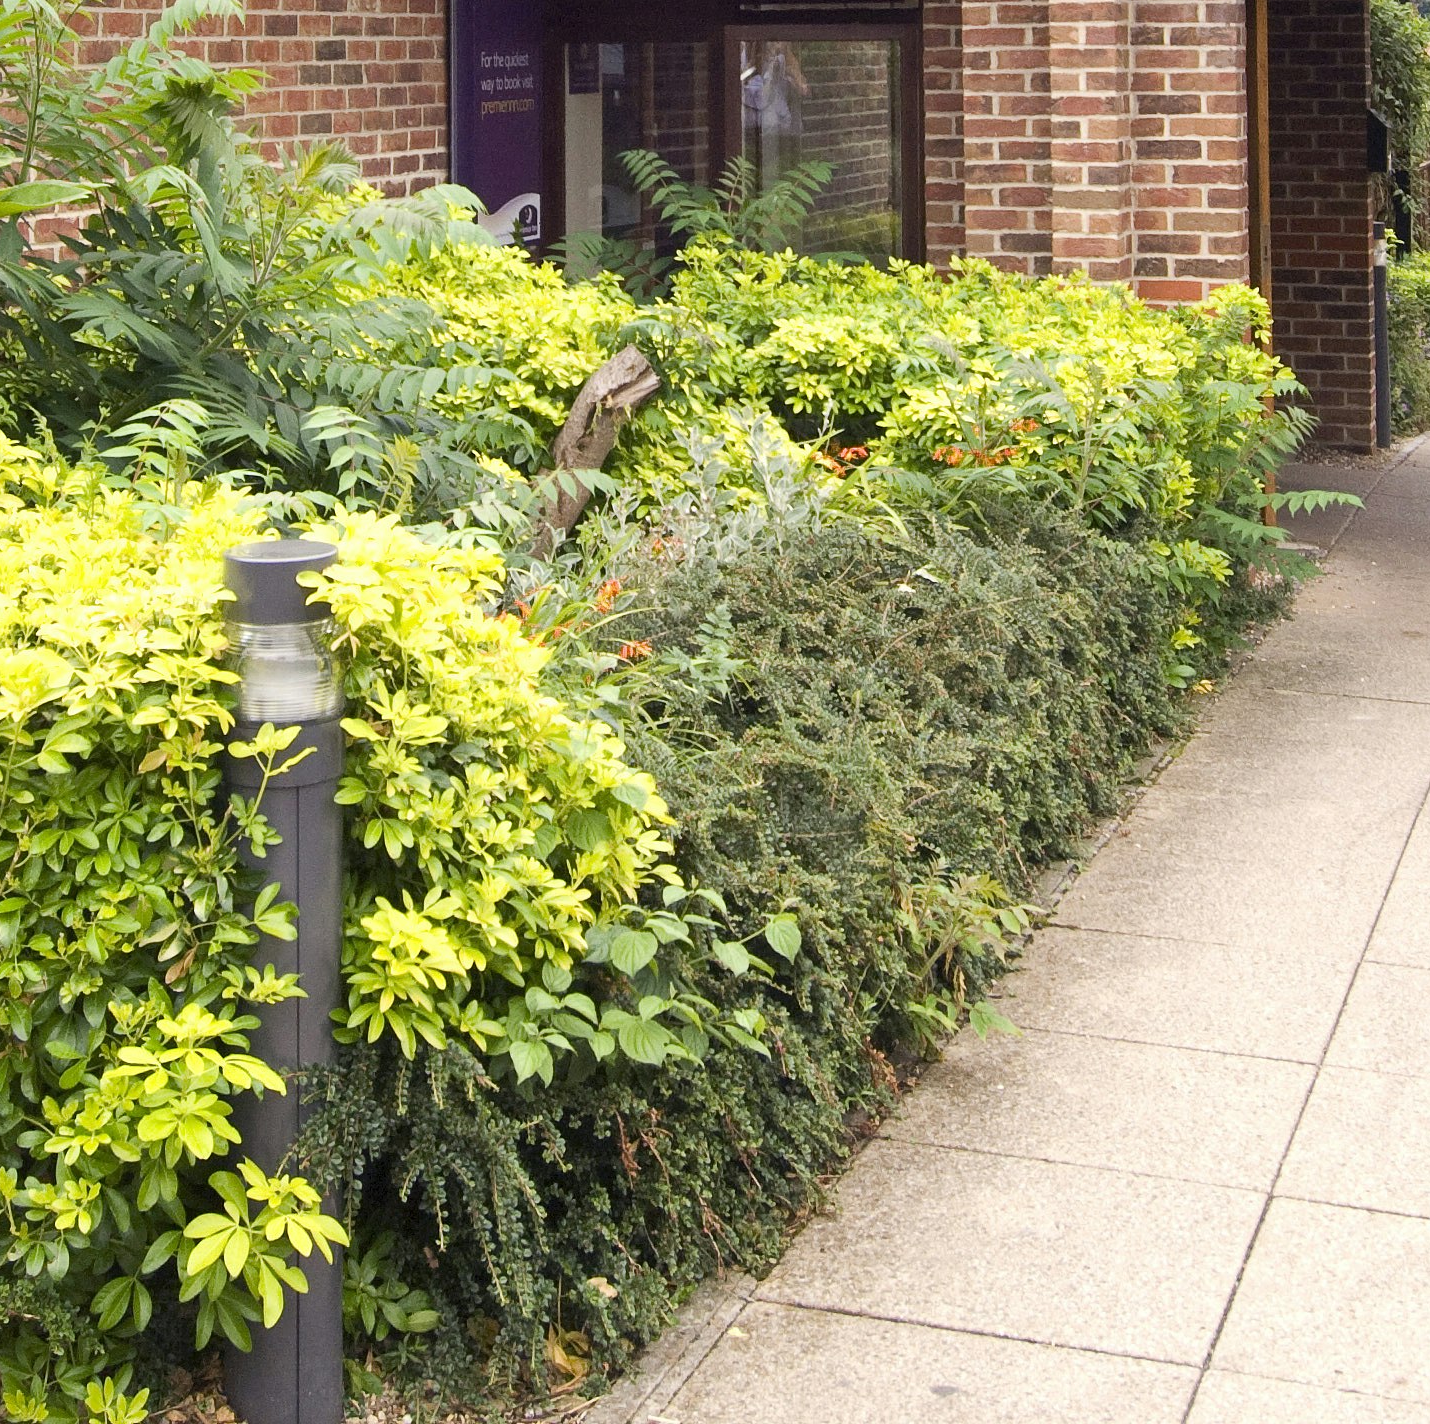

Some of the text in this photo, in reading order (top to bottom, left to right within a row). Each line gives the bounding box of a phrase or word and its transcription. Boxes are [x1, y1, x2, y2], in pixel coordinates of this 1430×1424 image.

[481, 51, 492, 68] For
[493, 51, 504, 67] the
[481, 79, 494, 95] way
[495, 77, 504, 90] to
[504, 74, 521, 90] book
